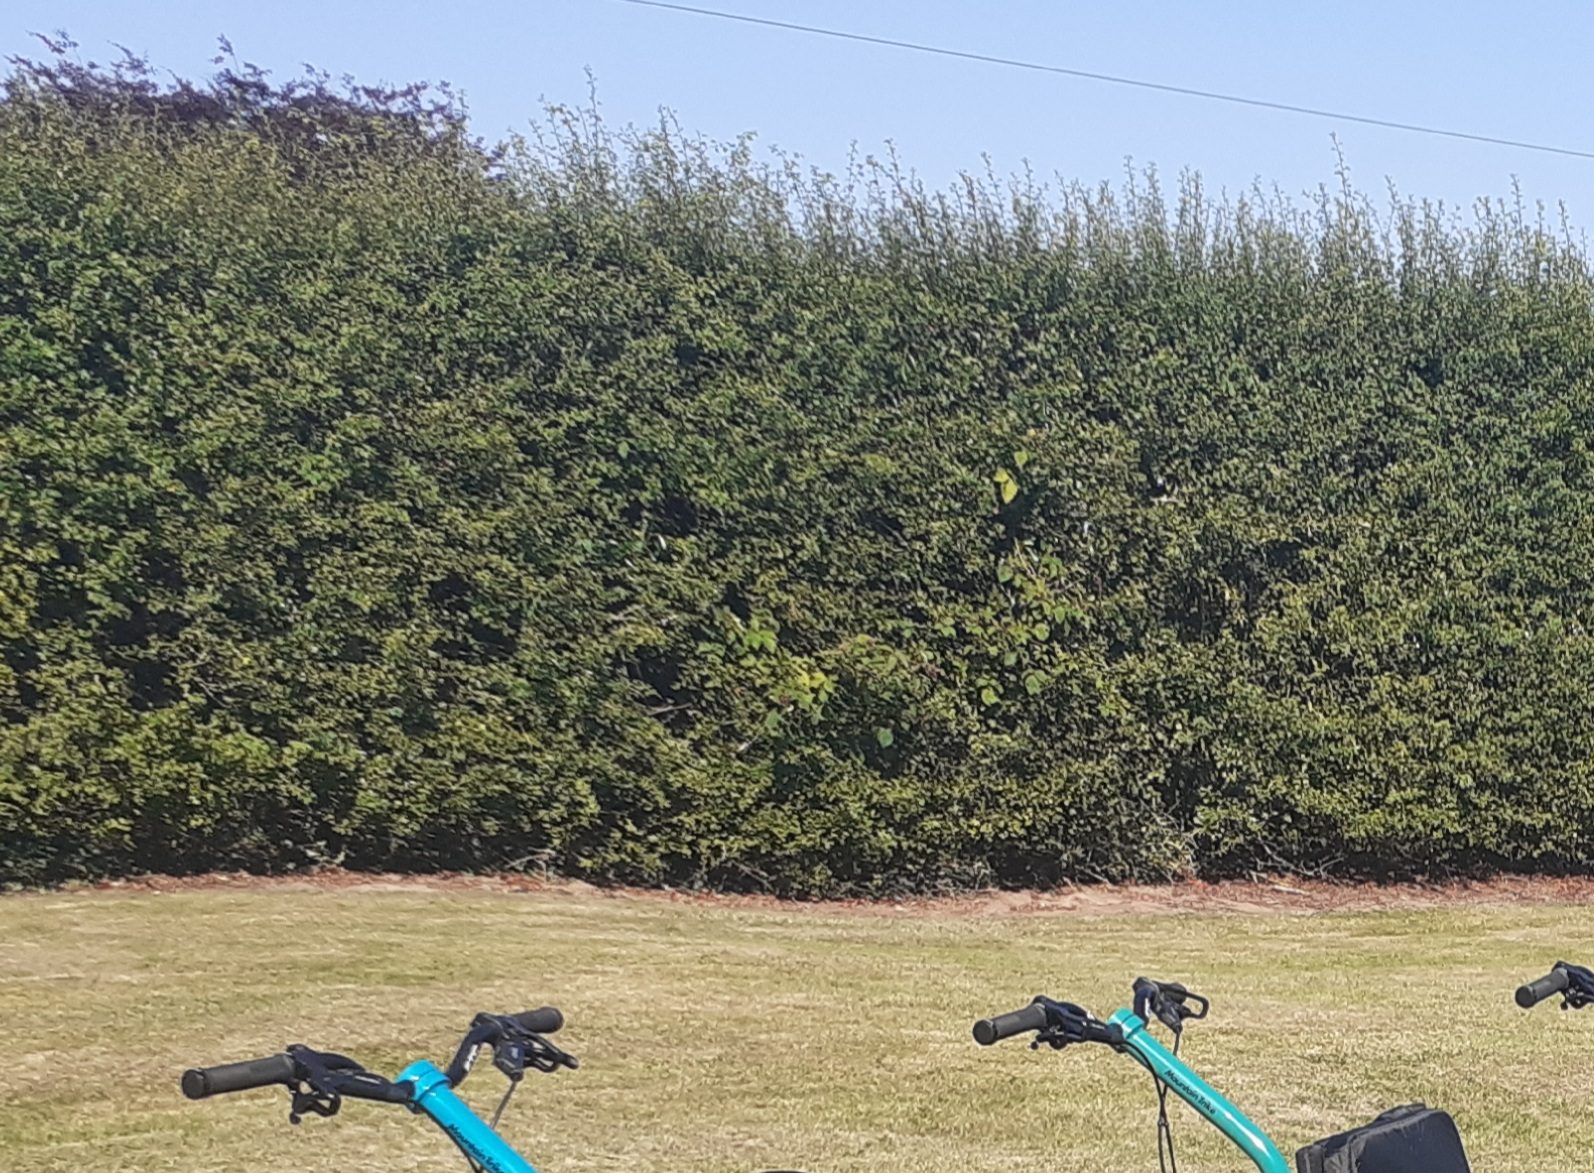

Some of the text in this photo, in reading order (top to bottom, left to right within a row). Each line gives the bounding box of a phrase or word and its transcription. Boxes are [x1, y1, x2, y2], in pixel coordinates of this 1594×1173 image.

[1164, 1069, 1216, 1115] Mountain Trike
[448, 1123, 487, 1160] Mountain
